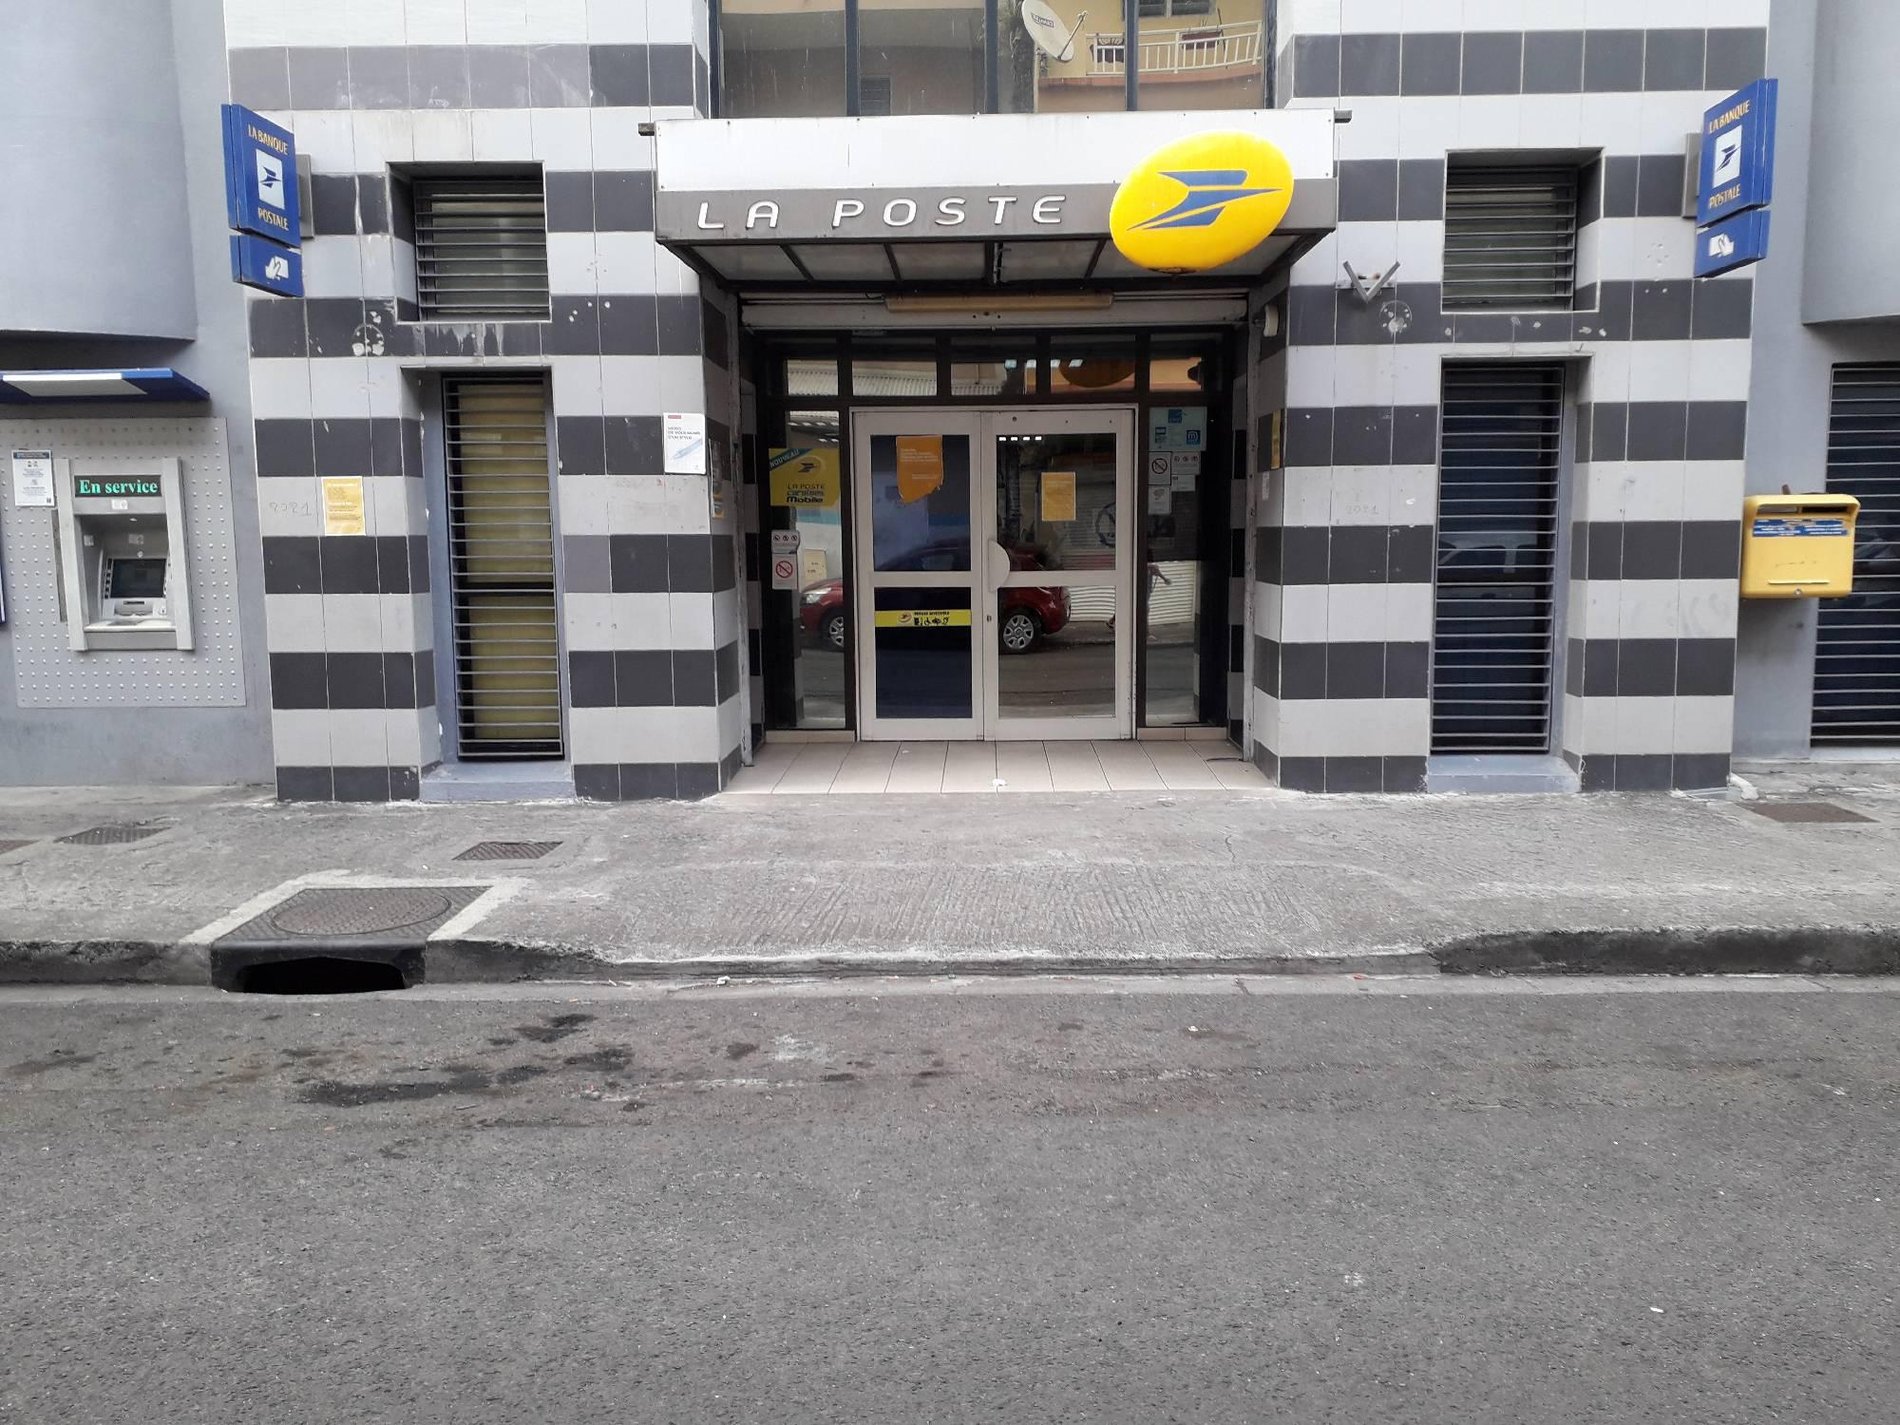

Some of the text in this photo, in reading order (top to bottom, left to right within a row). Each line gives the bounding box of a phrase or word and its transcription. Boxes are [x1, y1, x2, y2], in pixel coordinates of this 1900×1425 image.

[1709, 100, 1750, 134] LA BANQUE
[248, 123, 289, 156] LA BANQUE
[1708, 183, 1741, 209] POSTALE
[258, 207, 289, 232] POSTALE
[697, 195, 1066, 229] LA POSTE
[80, 479, 158, 494] En service
